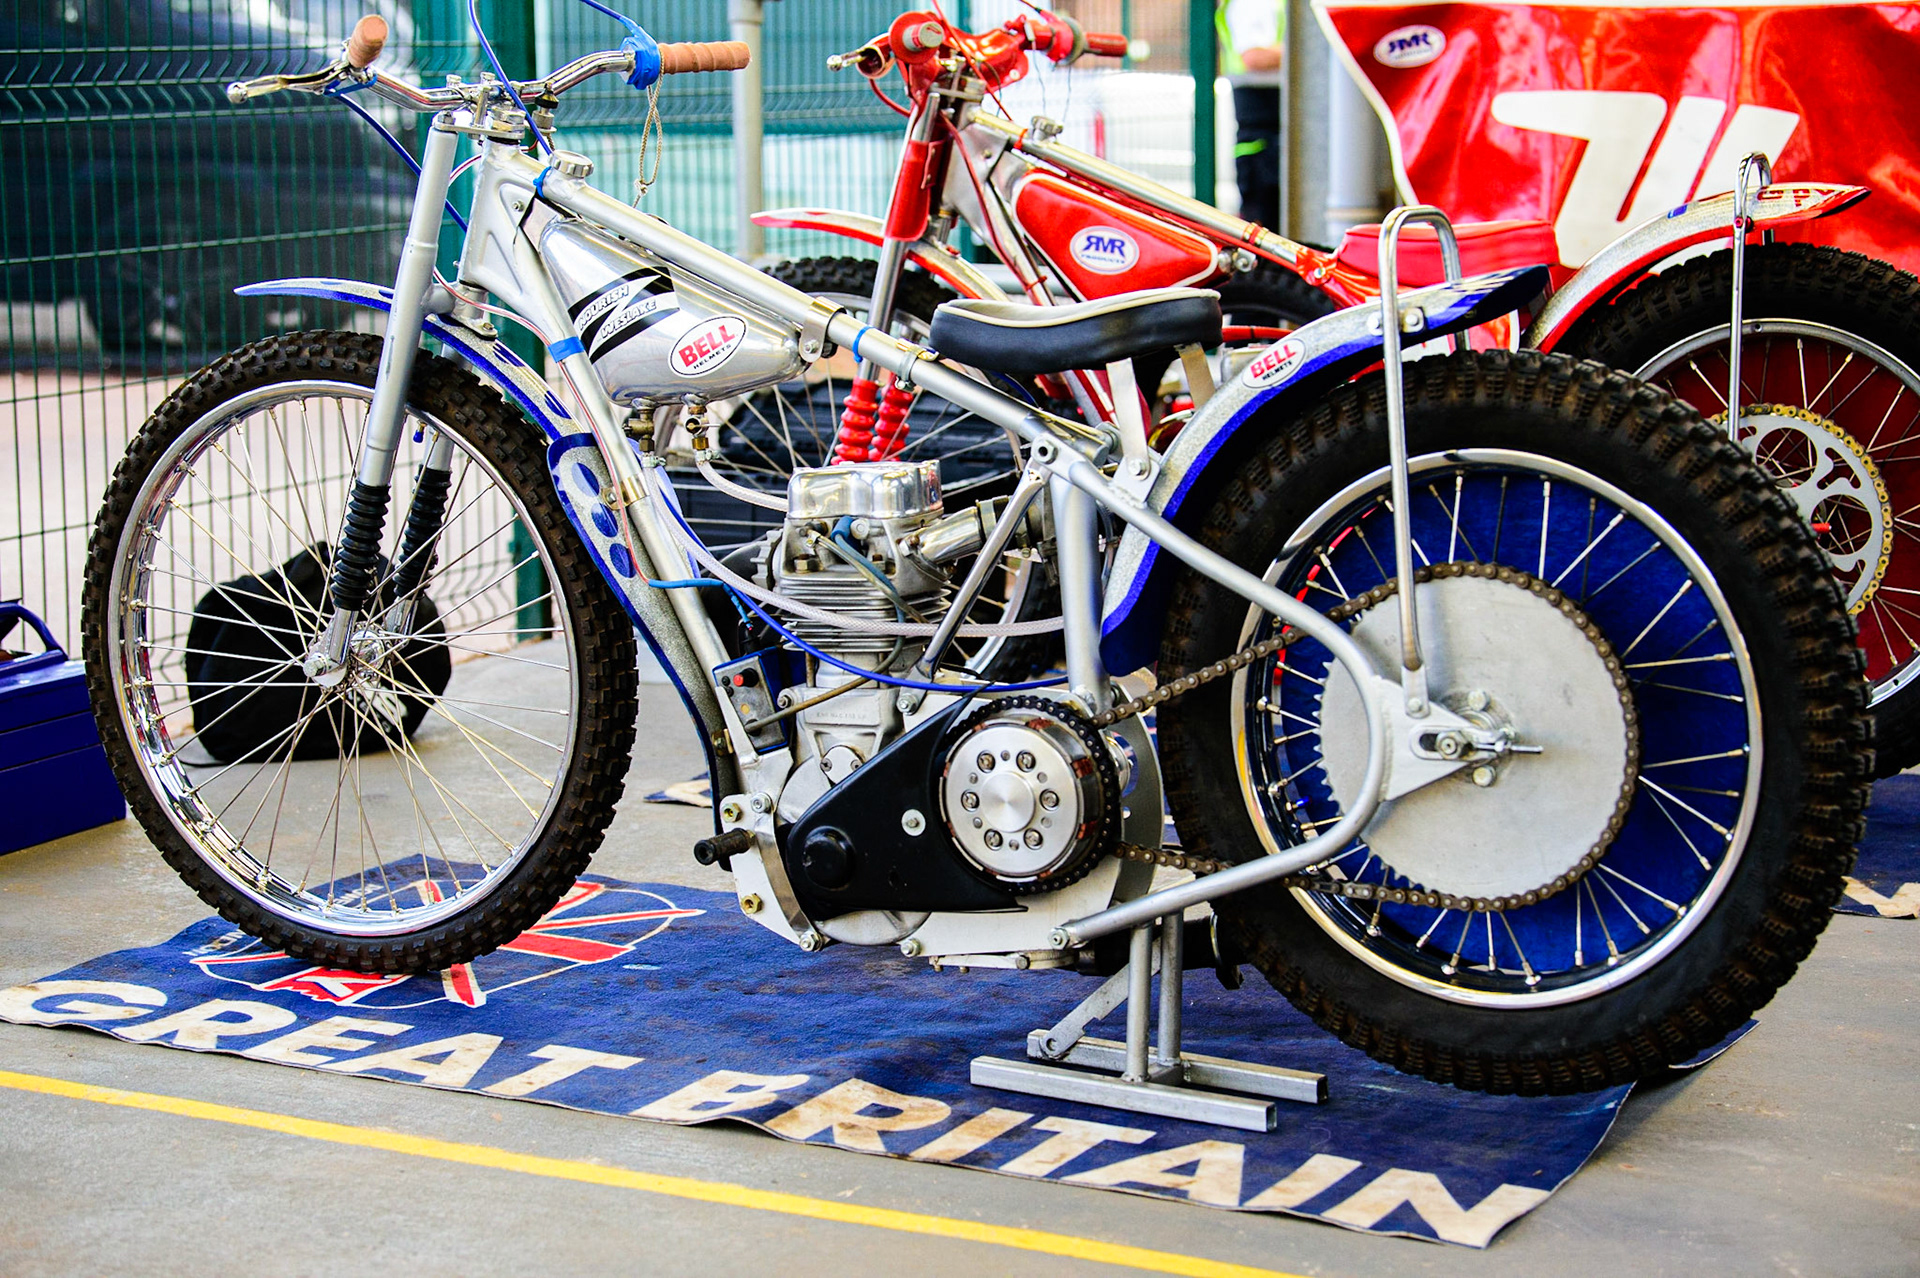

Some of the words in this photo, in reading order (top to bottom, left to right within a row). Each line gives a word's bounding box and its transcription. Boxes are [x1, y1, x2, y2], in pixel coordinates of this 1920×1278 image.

[578, 284, 630, 331] NOURISH
[601, 299, 657, 338] WESLAKE
[678, 325, 735, 367] BELL
[693, 344, 731, 369] HELMETS
[1250, 344, 1296, 378] BELL
[1262, 360, 1292, 380] HELMETS
[0, 980, 644, 1096] GREAT
[630, 1070, 1552, 1249] BRITAIN
